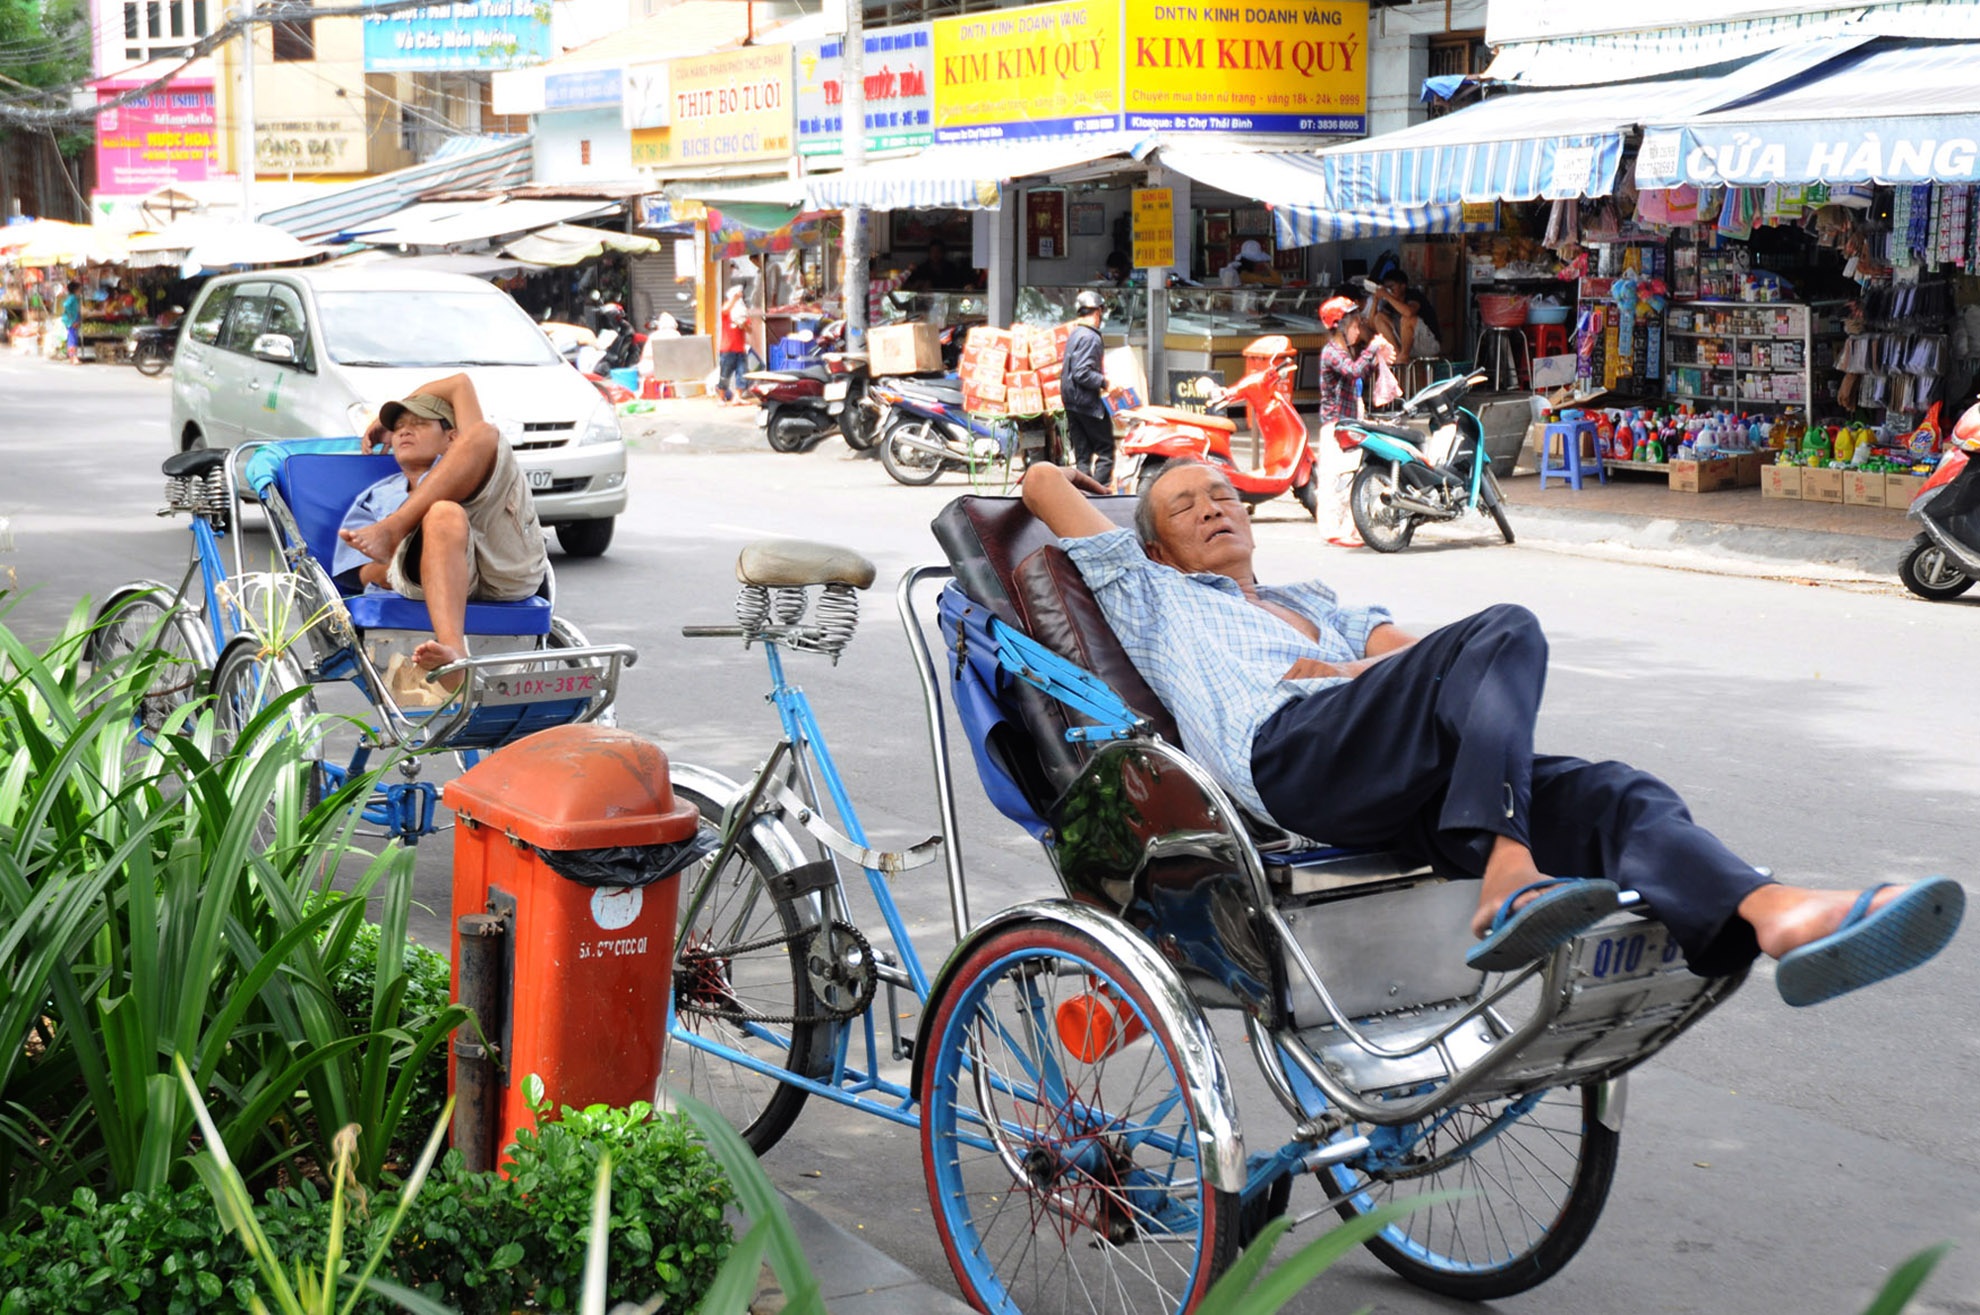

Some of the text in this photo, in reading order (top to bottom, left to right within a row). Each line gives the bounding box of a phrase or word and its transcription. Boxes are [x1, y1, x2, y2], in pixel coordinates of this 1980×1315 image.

[960, 23, 986, 41] DNTN
[991, 21, 1014, 37] KINH
[1018, 15, 1055, 33] DOANH
[1154, 6, 1343, 26] DNTN KINH DOANH VÀNG
[943, 28, 1107, 86] KIM KIM QUÝ
[1135, 32, 1360, 78] KIM KIM QUÝ
[1132, 88, 1170, 104] Chuyên
[1173, 91, 1194, 102] mua
[1196, 89, 1214, 102] bán
[1231, 91, 1257, 106] trang
[1267, 90, 1290, 107] vàng
[1315, 93, 1333, 105] 24k
[1188, 117, 1209, 132] Chợ
[1231, 116, 1254, 130] Bình
[1685, 131, 1787, 181] CỬA
[1805, 129, 1980, 180] HÀNG
